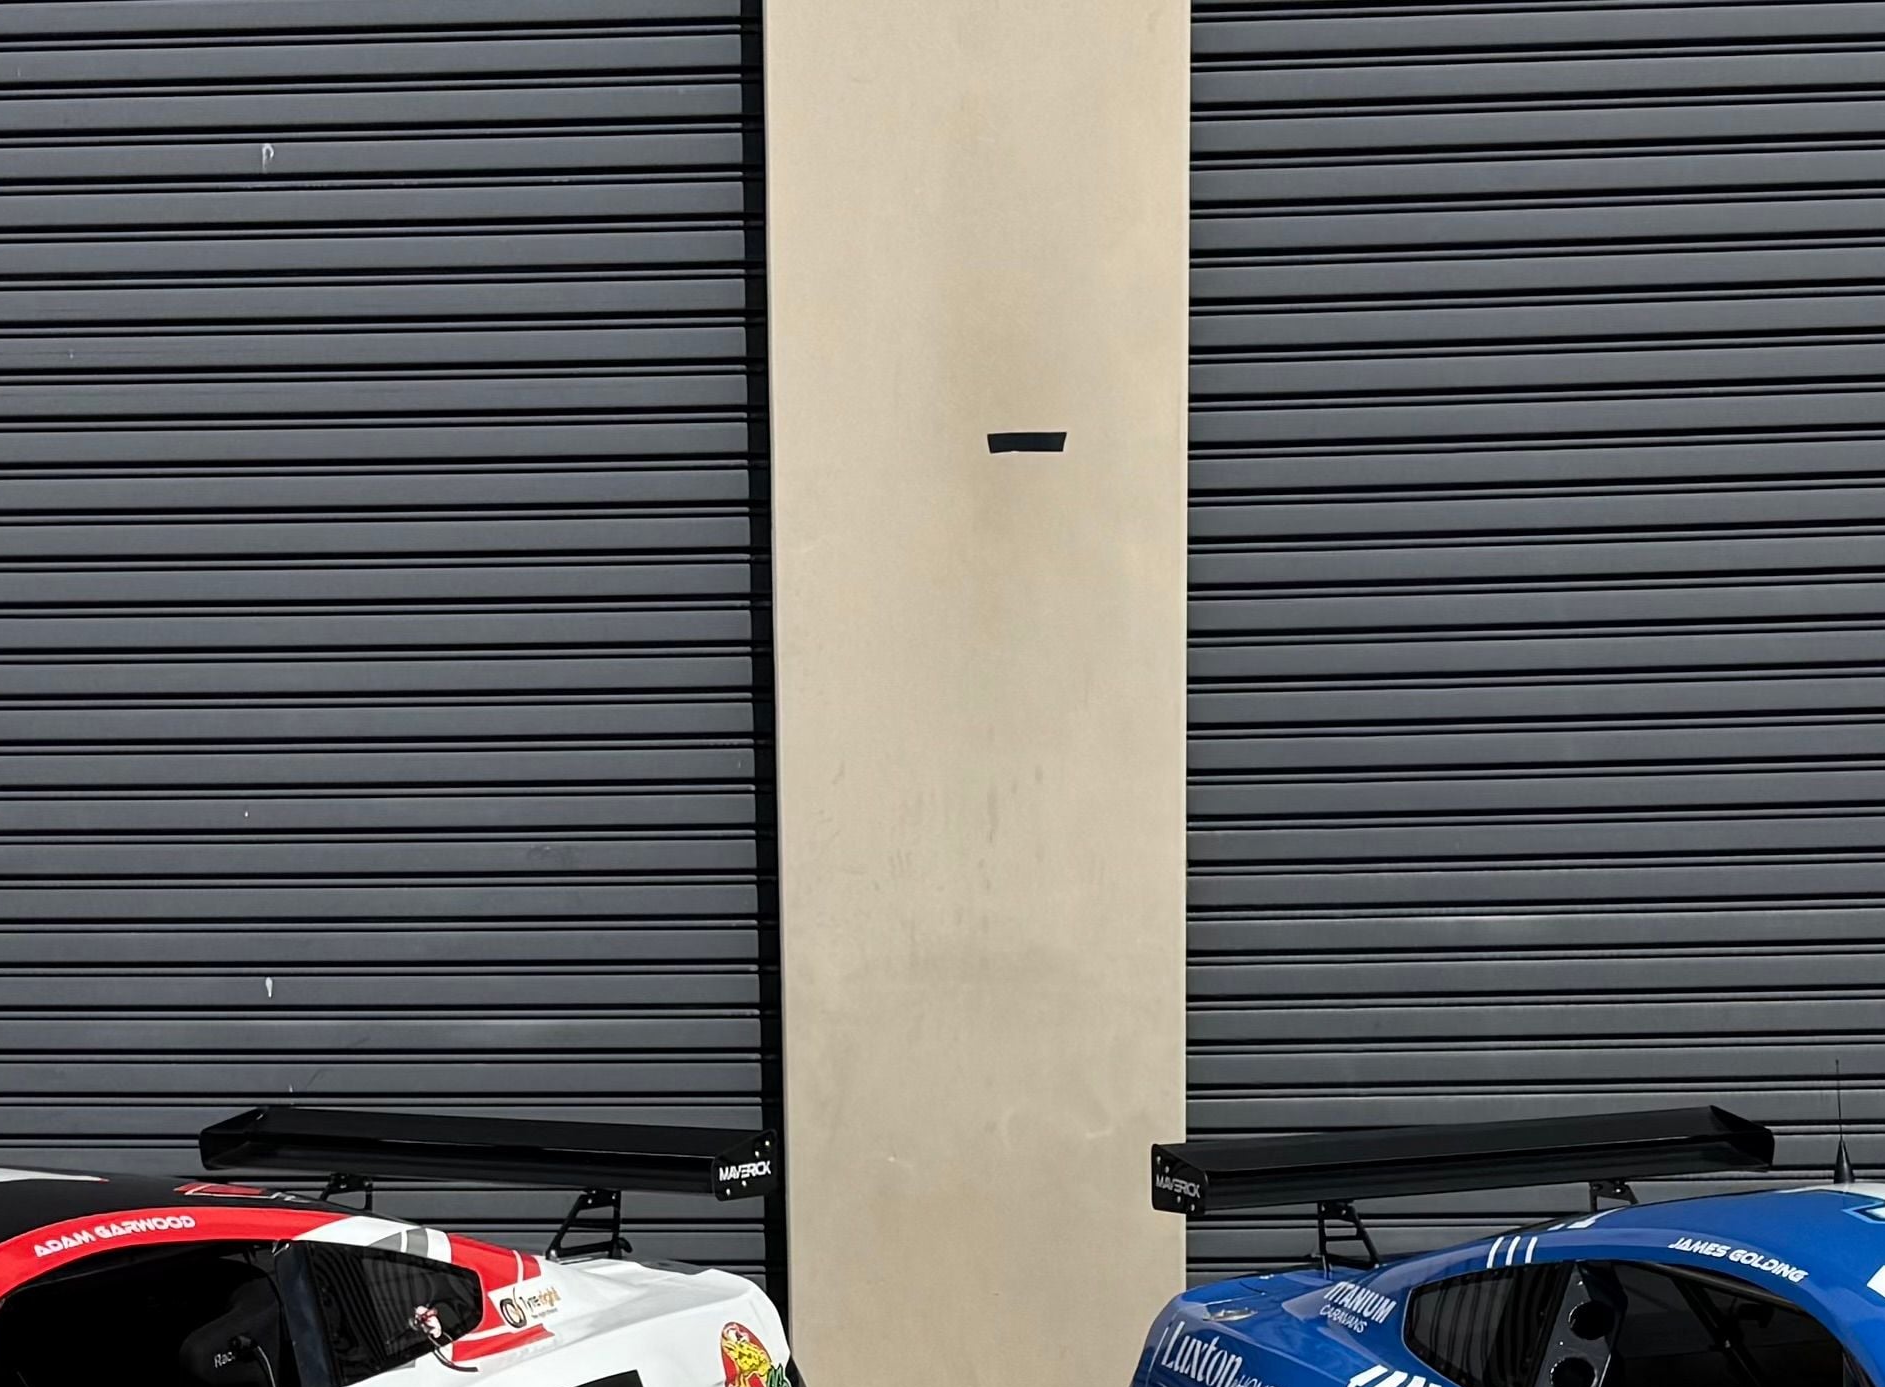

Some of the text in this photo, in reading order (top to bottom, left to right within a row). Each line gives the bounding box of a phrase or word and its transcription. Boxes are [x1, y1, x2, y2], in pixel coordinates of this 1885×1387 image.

[719, 1160, 772, 1181] MAVERICK
[33, 1215, 196, 1258] ADAM GARWOOD
[1667, 1237, 1810, 1283] JAMES GOLDING
[1319, 1304, 1370, 1334] CARAVANS
[1323, 1281, 1397, 1324] TITANIUM
